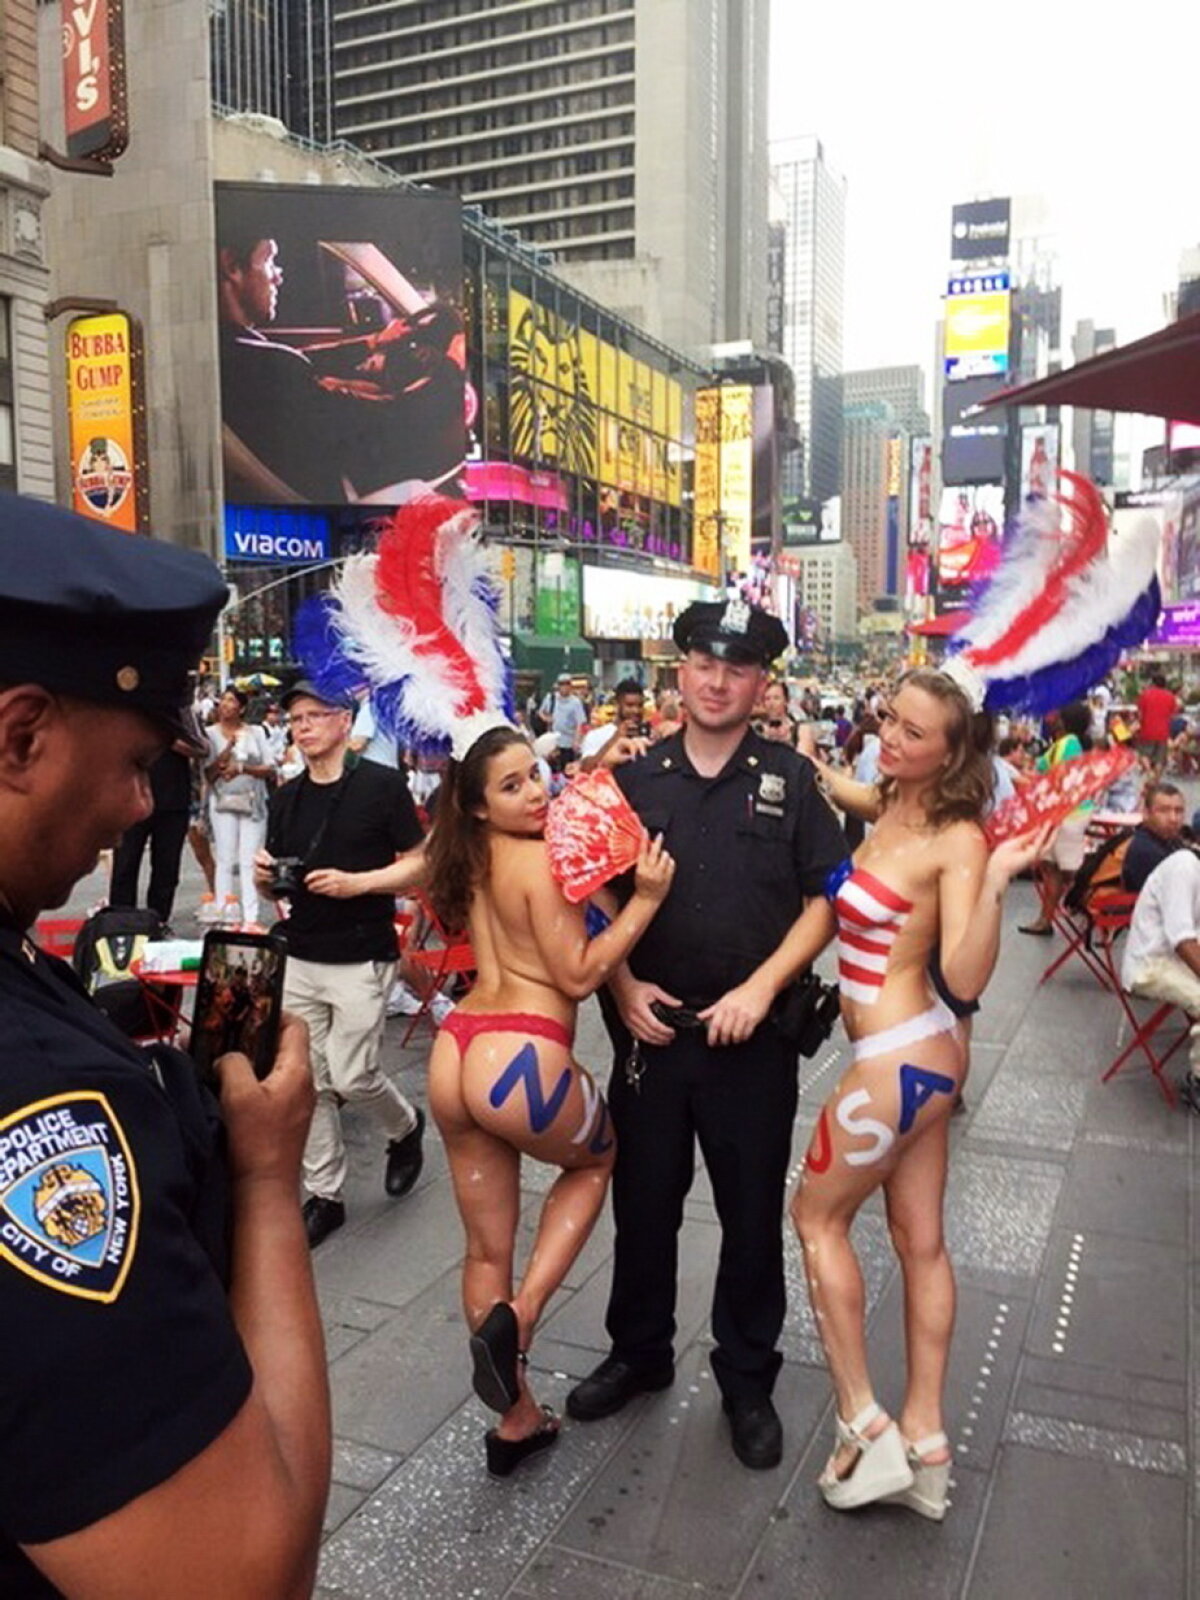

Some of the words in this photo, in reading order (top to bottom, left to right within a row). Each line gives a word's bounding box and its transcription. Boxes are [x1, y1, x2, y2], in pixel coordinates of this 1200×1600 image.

[71, 332, 126, 359] BUBBA
[77, 364, 123, 391] GUMP
[0, 1109, 76, 1160] POLICE
[806, 1064, 956, 1174] USA
[0, 1122, 109, 1190] EPARTMENT
[110, 1153, 130, 1211] YORK
[1, 1222, 49, 1263] CITY
[51, 1258, 83, 1279] OF
[107, 1218, 128, 1264] NEW
